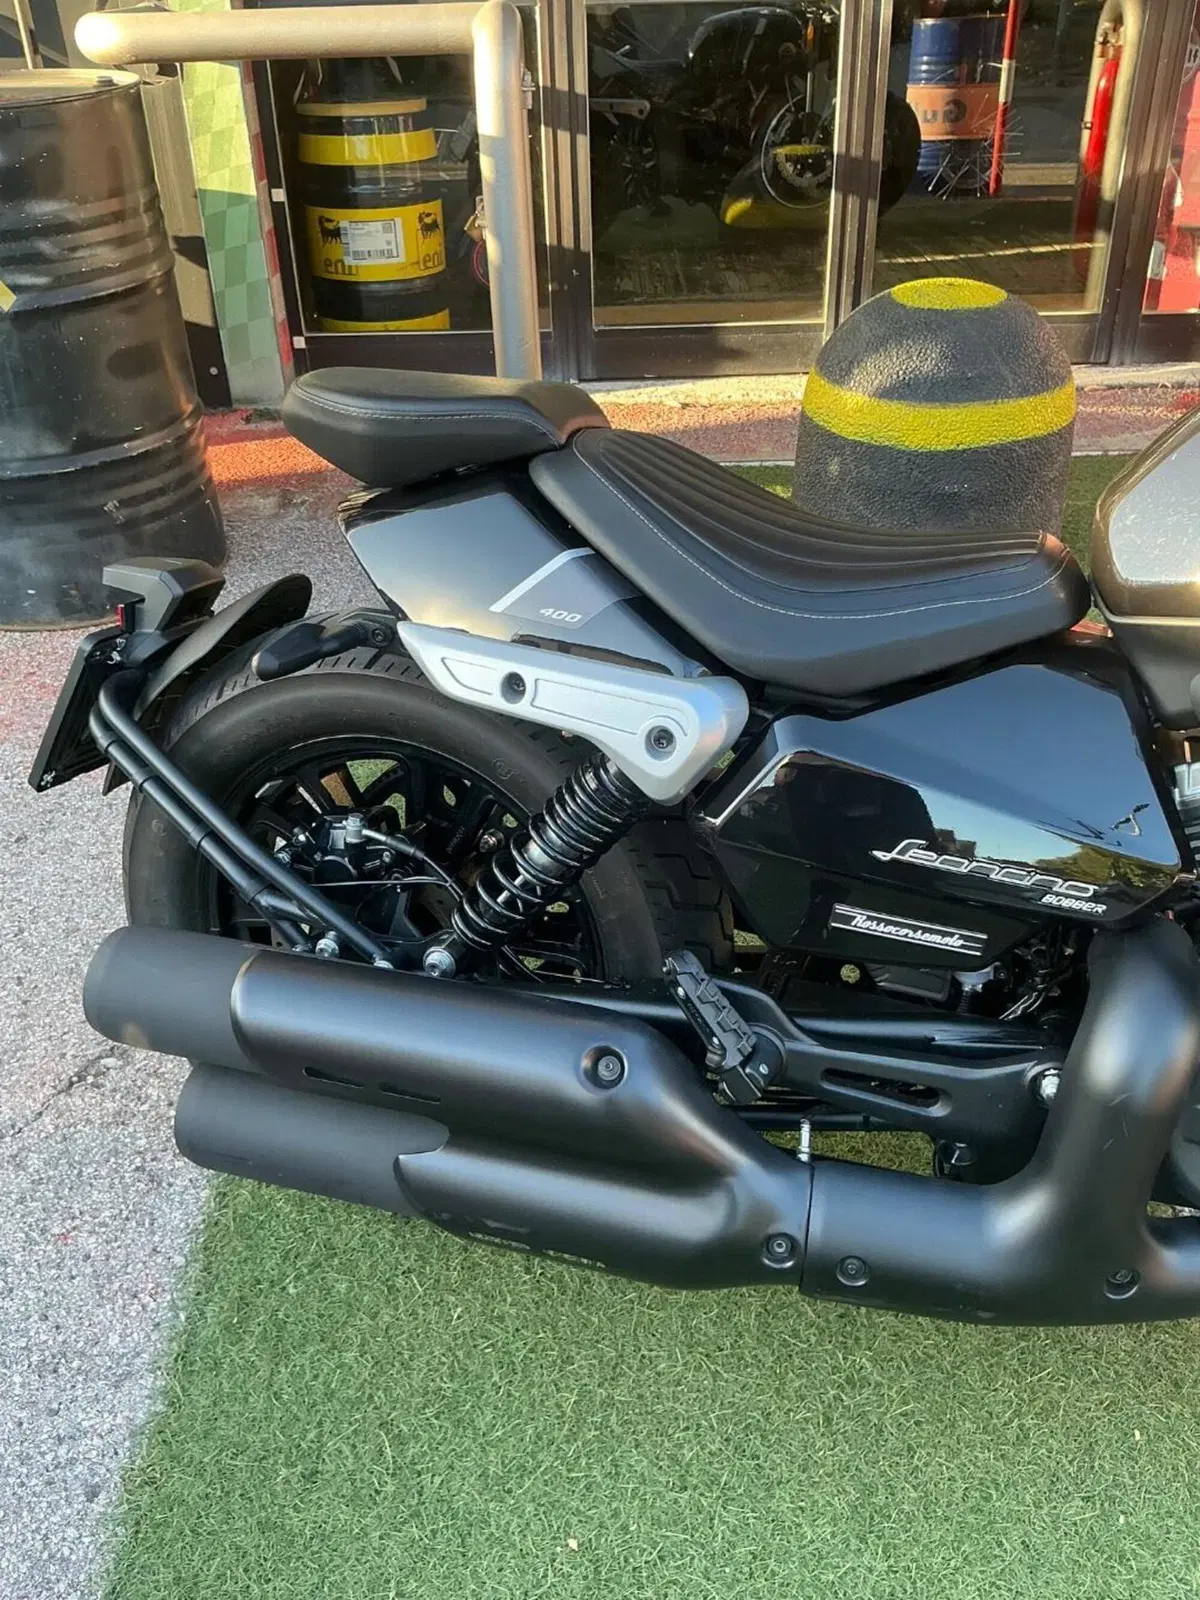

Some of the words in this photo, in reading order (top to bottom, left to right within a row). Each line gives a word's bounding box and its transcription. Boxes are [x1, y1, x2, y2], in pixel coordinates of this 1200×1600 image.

[540, 608, 582, 622] 400
[871, 839, 1099, 897] Leoncino
[1041, 894, 1107, 914] BOBBER
[850, 913, 964, 947] Rossocorsemoto
